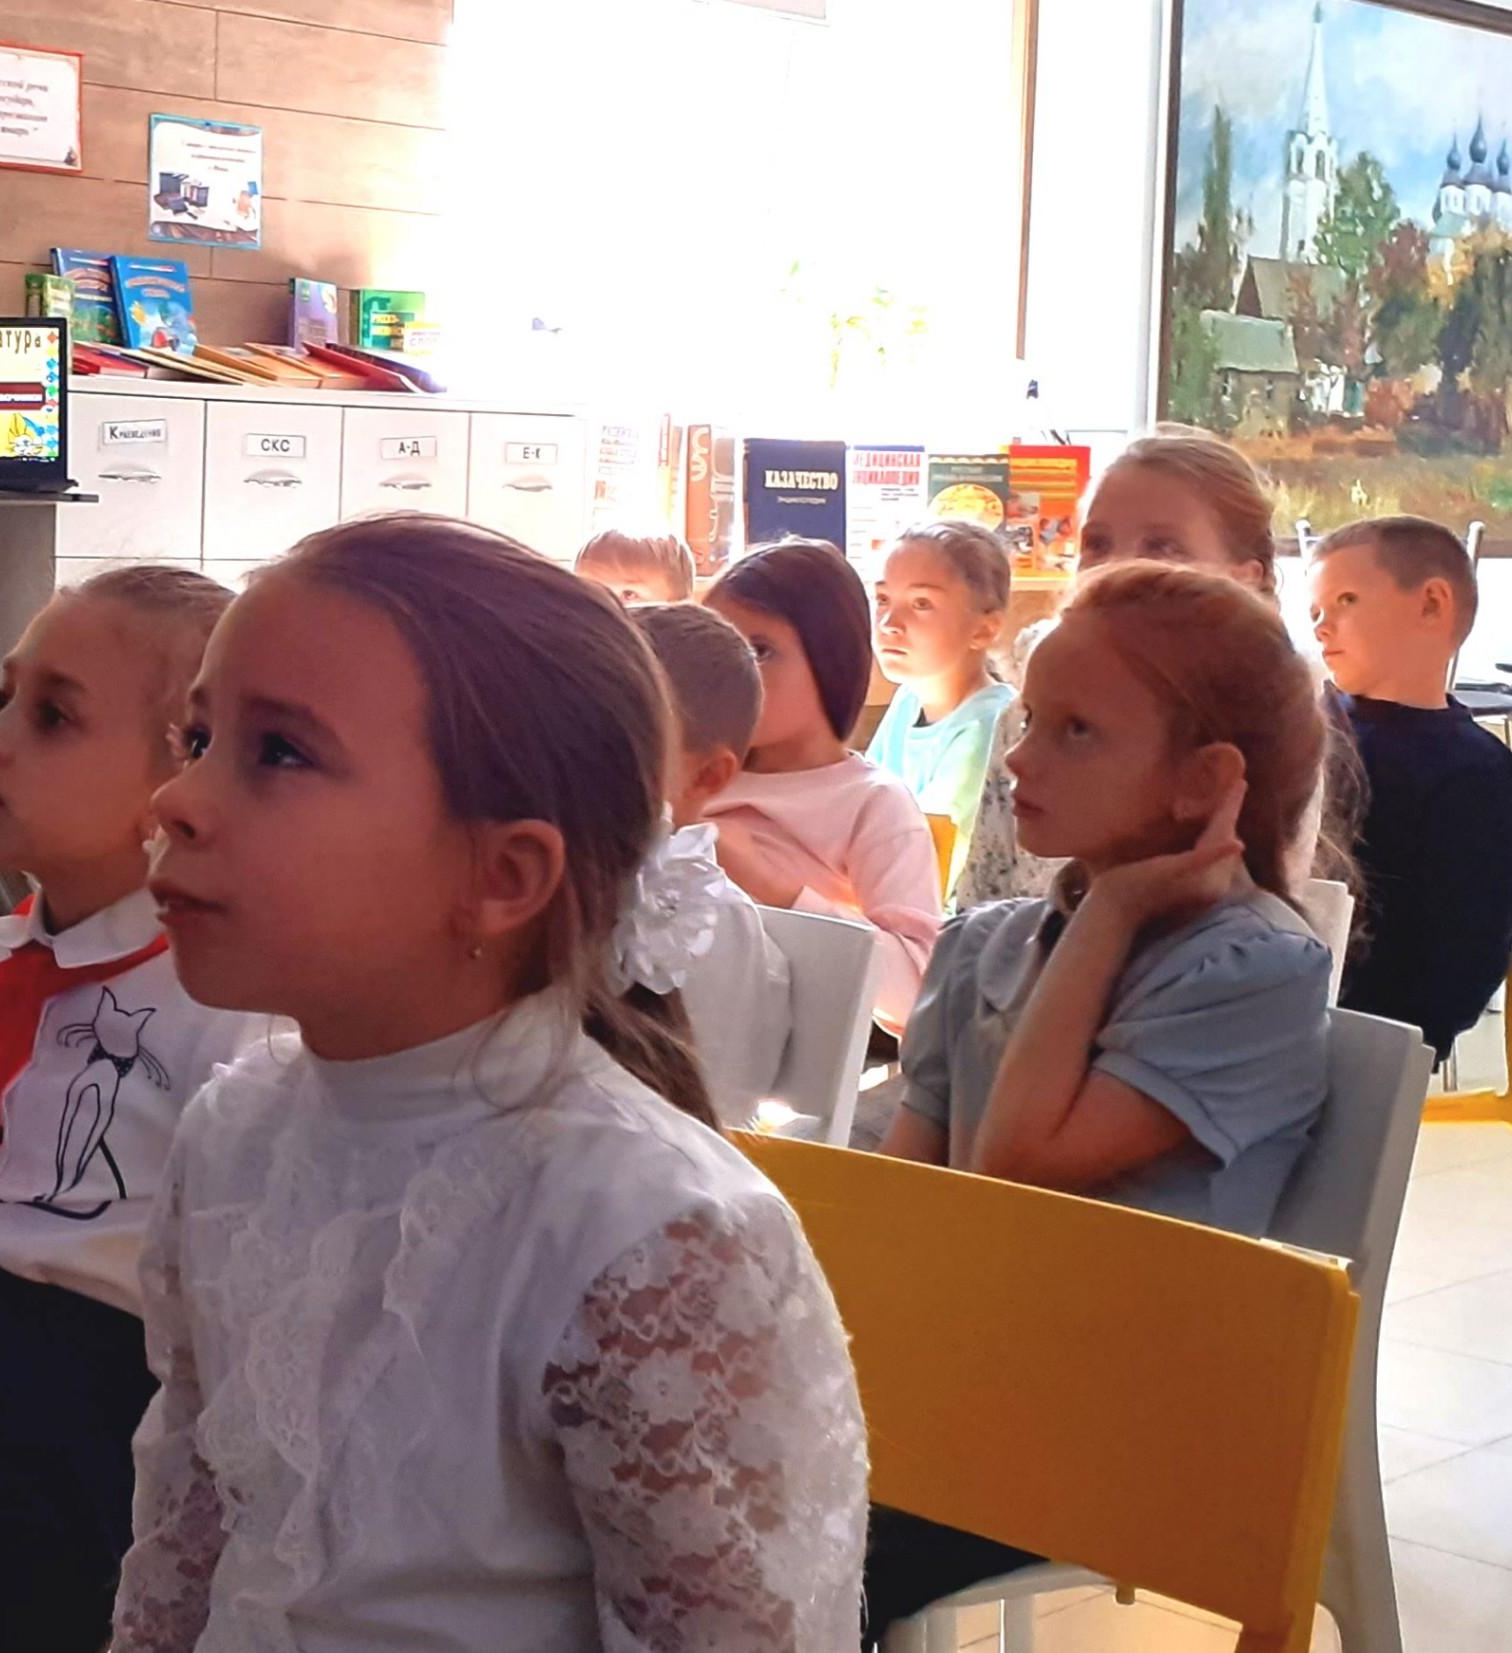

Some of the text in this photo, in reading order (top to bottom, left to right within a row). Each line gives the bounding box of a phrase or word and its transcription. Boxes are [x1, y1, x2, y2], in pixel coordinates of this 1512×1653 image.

[261, 440, 291, 453] СКС
[398, 440, 421, 457] А-Д
[764, 470, 839, 490] КАЗАЧЕСТВО
